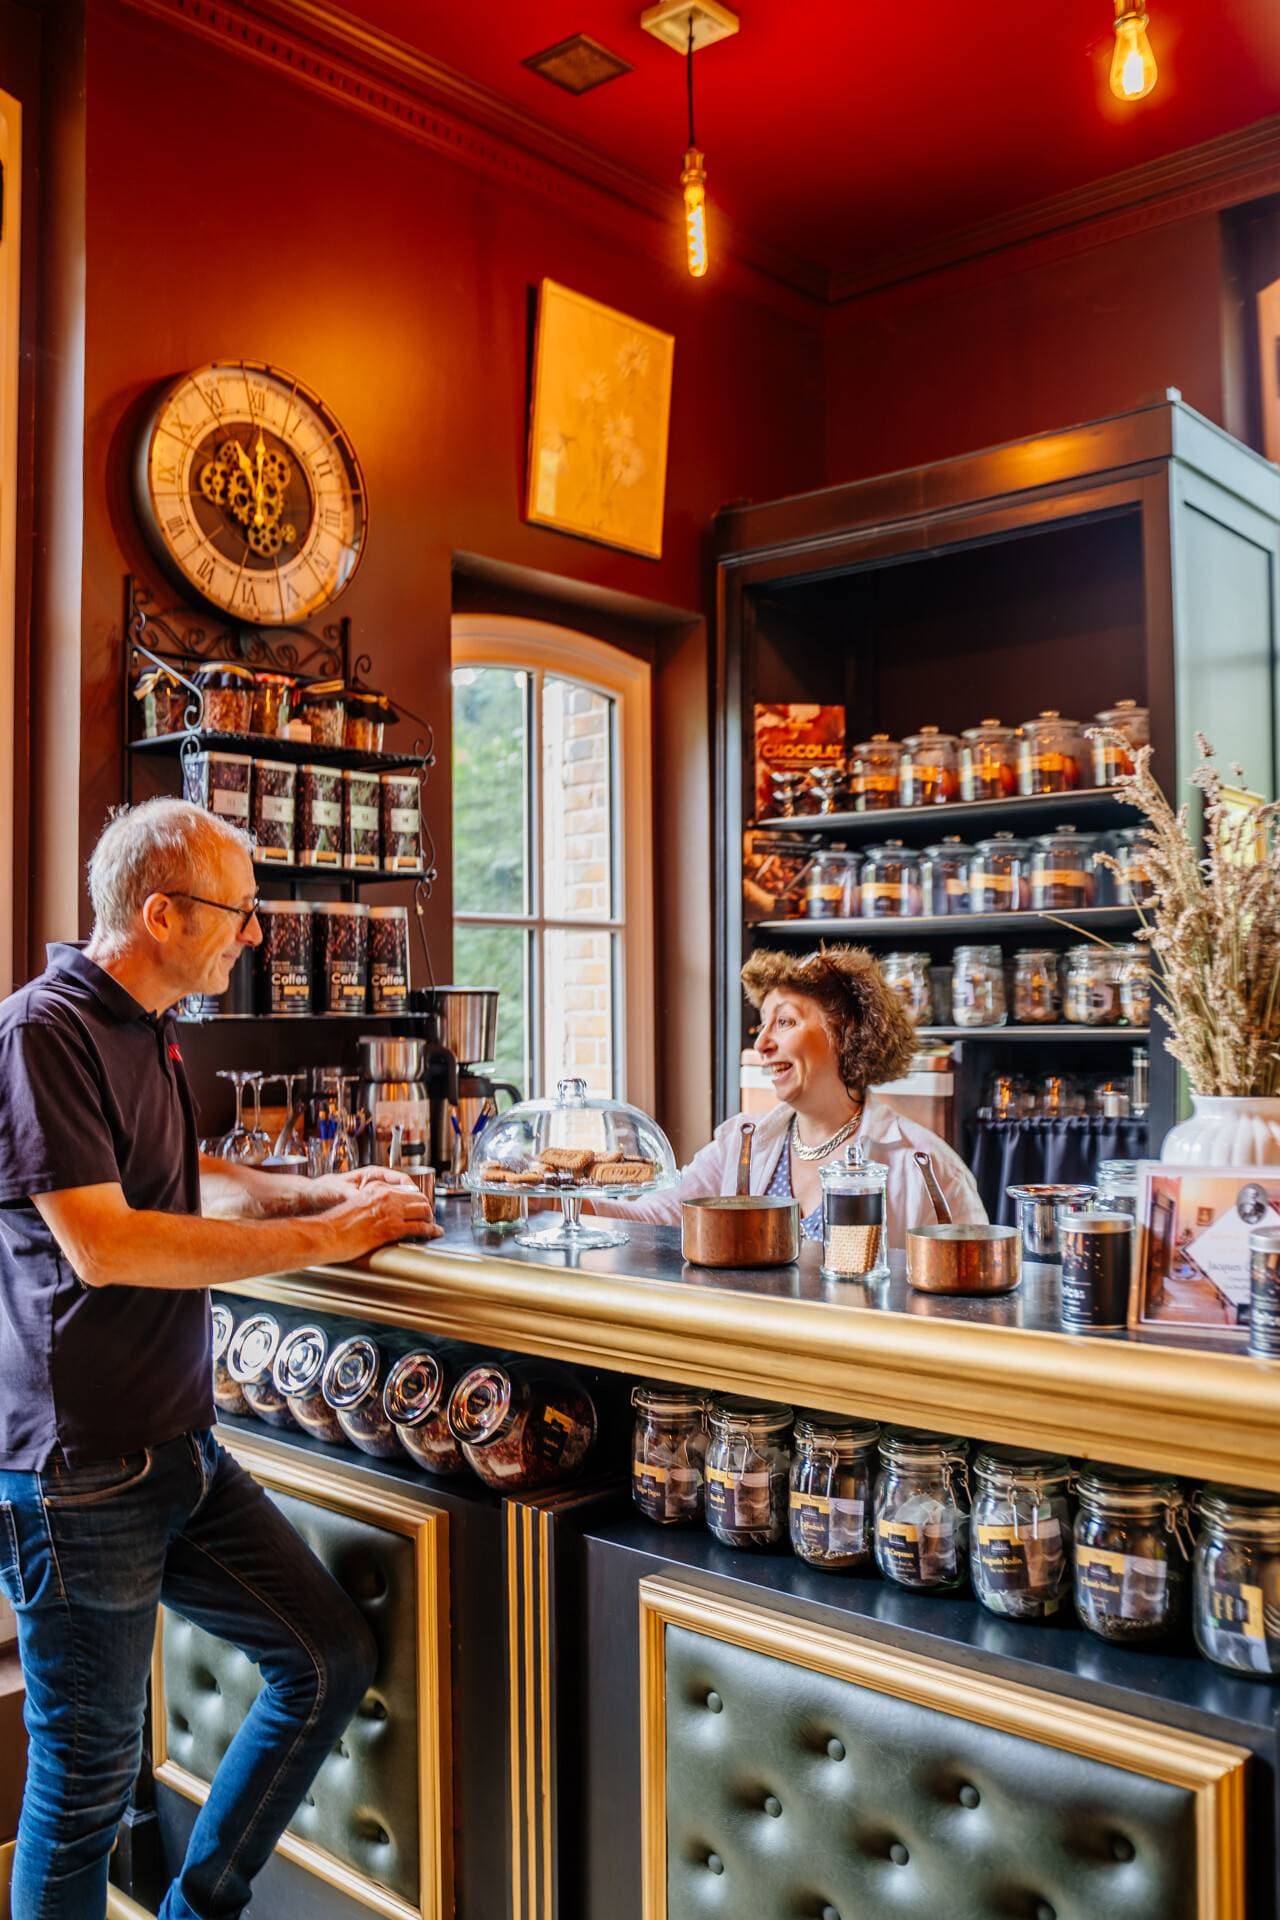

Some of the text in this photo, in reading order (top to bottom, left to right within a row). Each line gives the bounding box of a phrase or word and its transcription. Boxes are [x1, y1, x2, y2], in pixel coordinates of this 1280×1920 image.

[204, 387, 225, 409] XI
[249, 386, 265, 411] XII
[170, 412, 193, 438] X
[315, 459, 333, 478] II
[196, 557, 216, 585] VII
[242, 582, 258, 606] VI
[762, 743, 844, 759] CHOCOLAT
[271, 972, 308, 986] Coffee
[331, 970, 358, 985] Café
[371, 973, 405, 987] Coffee
